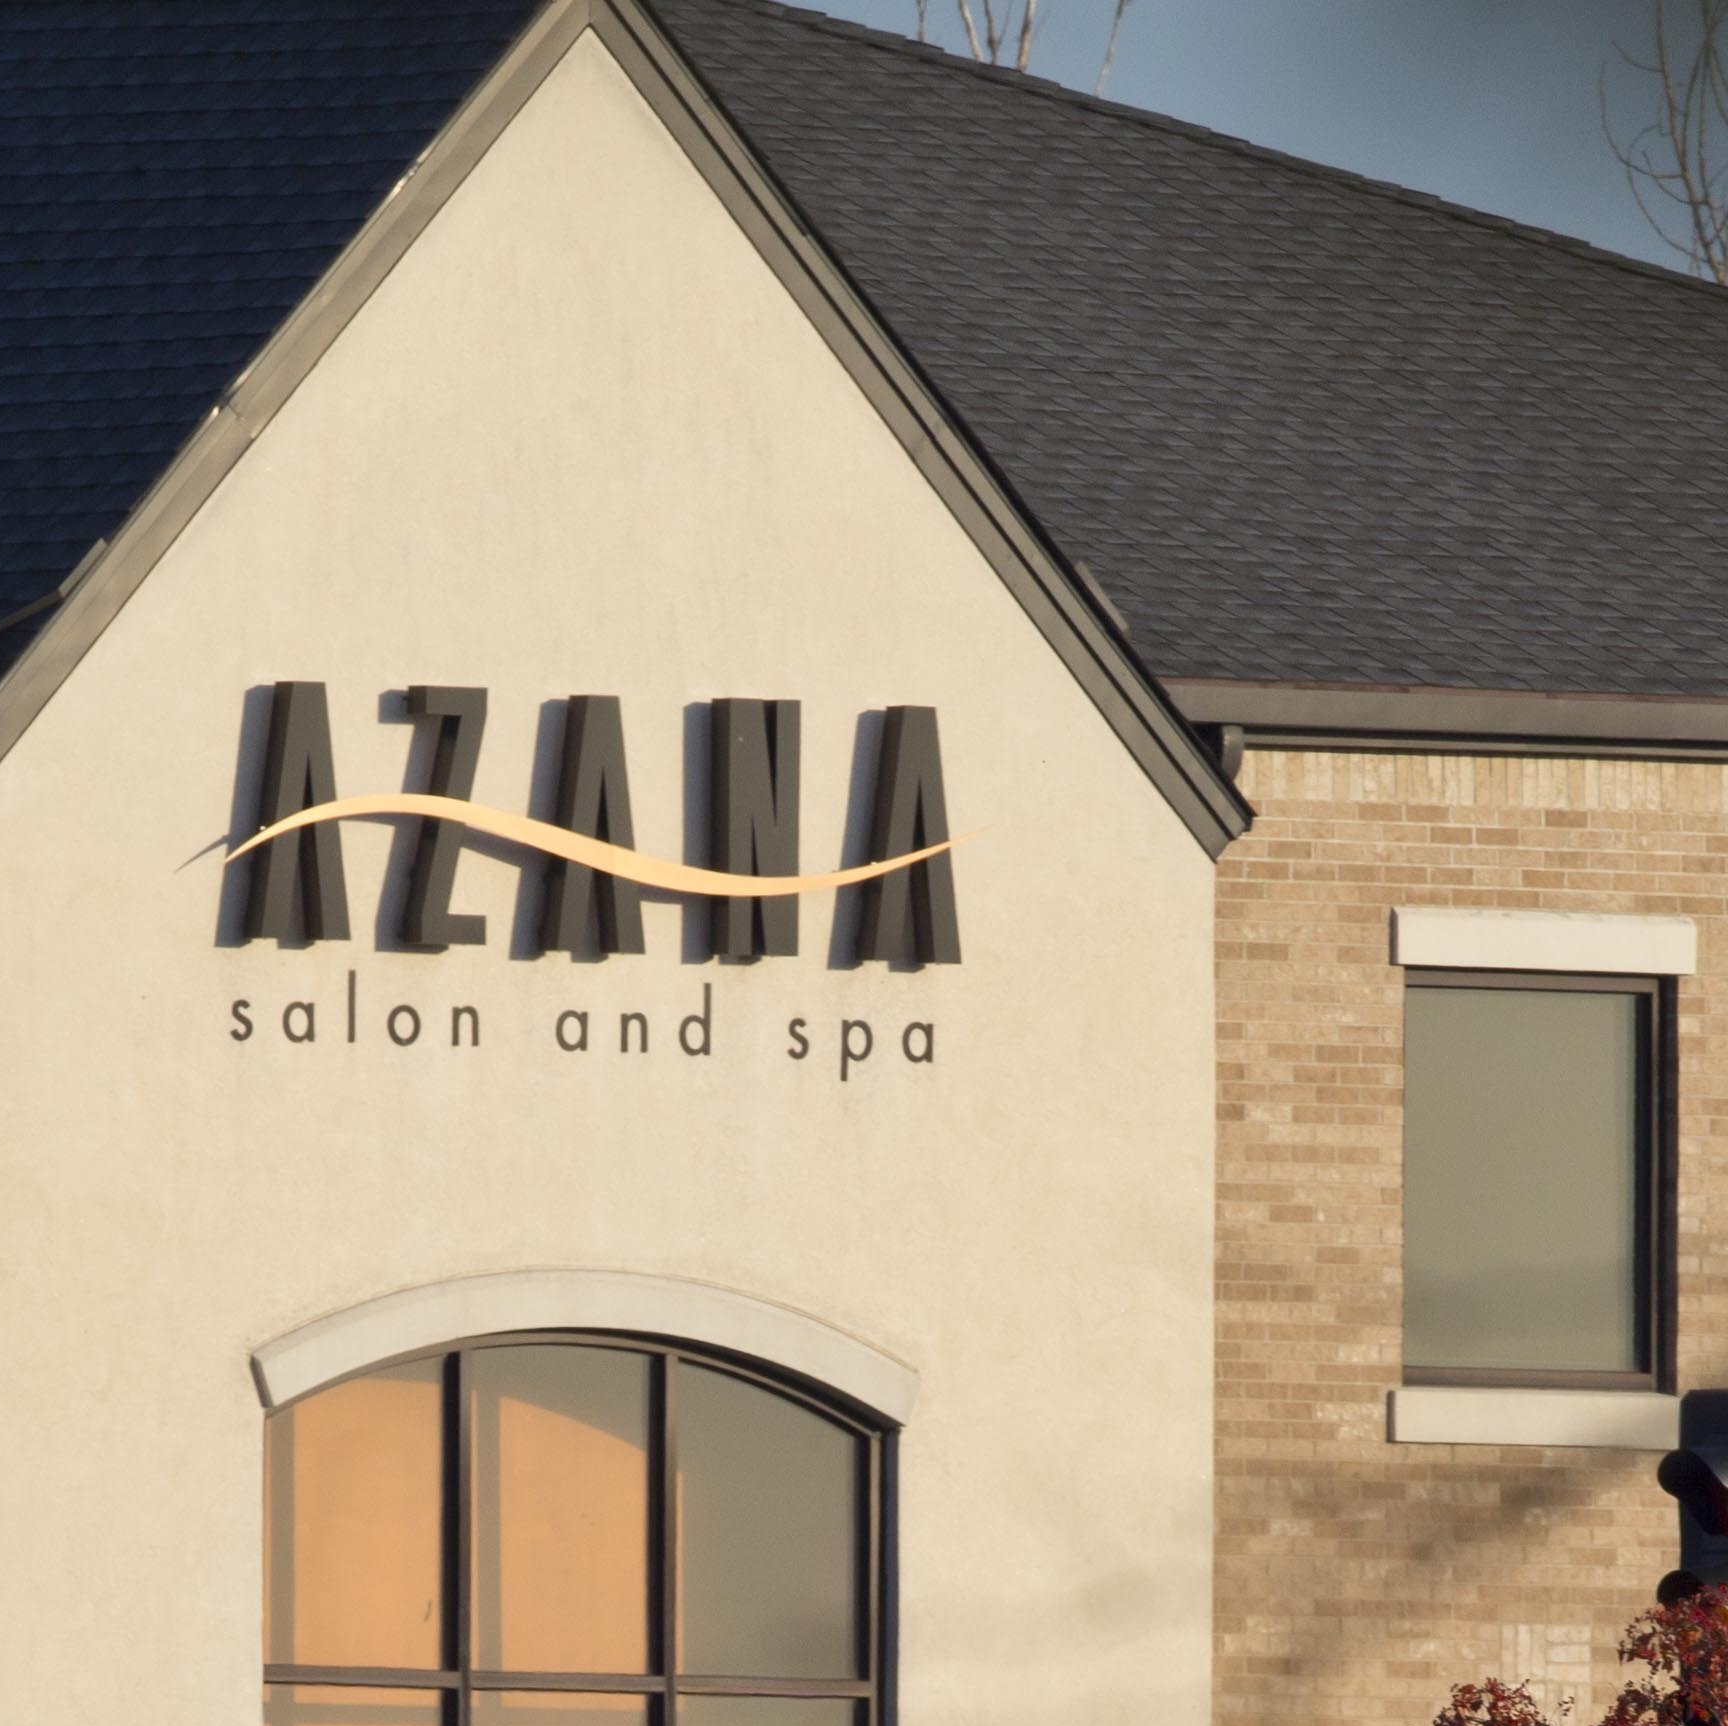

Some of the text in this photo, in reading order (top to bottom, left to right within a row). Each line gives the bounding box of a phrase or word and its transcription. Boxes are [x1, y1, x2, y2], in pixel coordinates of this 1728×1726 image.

[240, 681, 962, 965] AZANA
[229, 969, 935, 1082] salon and spa
